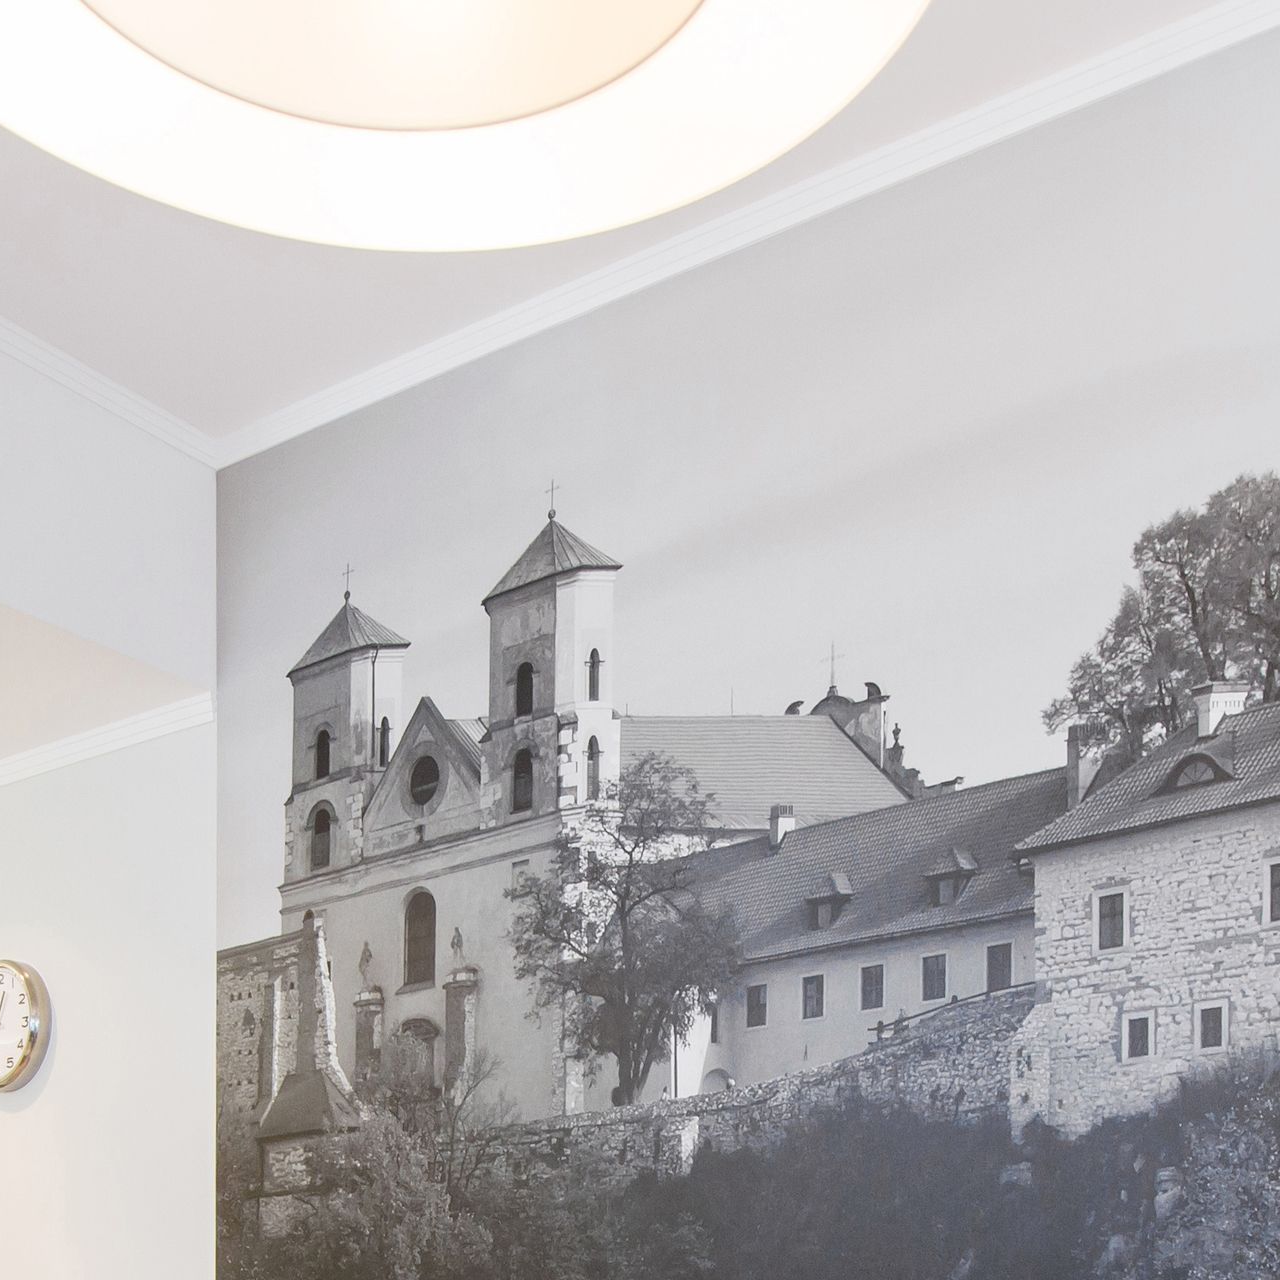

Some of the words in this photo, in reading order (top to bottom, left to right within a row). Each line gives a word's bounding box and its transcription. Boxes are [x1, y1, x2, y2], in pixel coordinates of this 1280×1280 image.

[18, 993, 26, 1005] 2
[22, 1016, 29, 1028] 3
[17, 1038, 24, 1049] 4
[6, 1058, 14, 1069] 5
